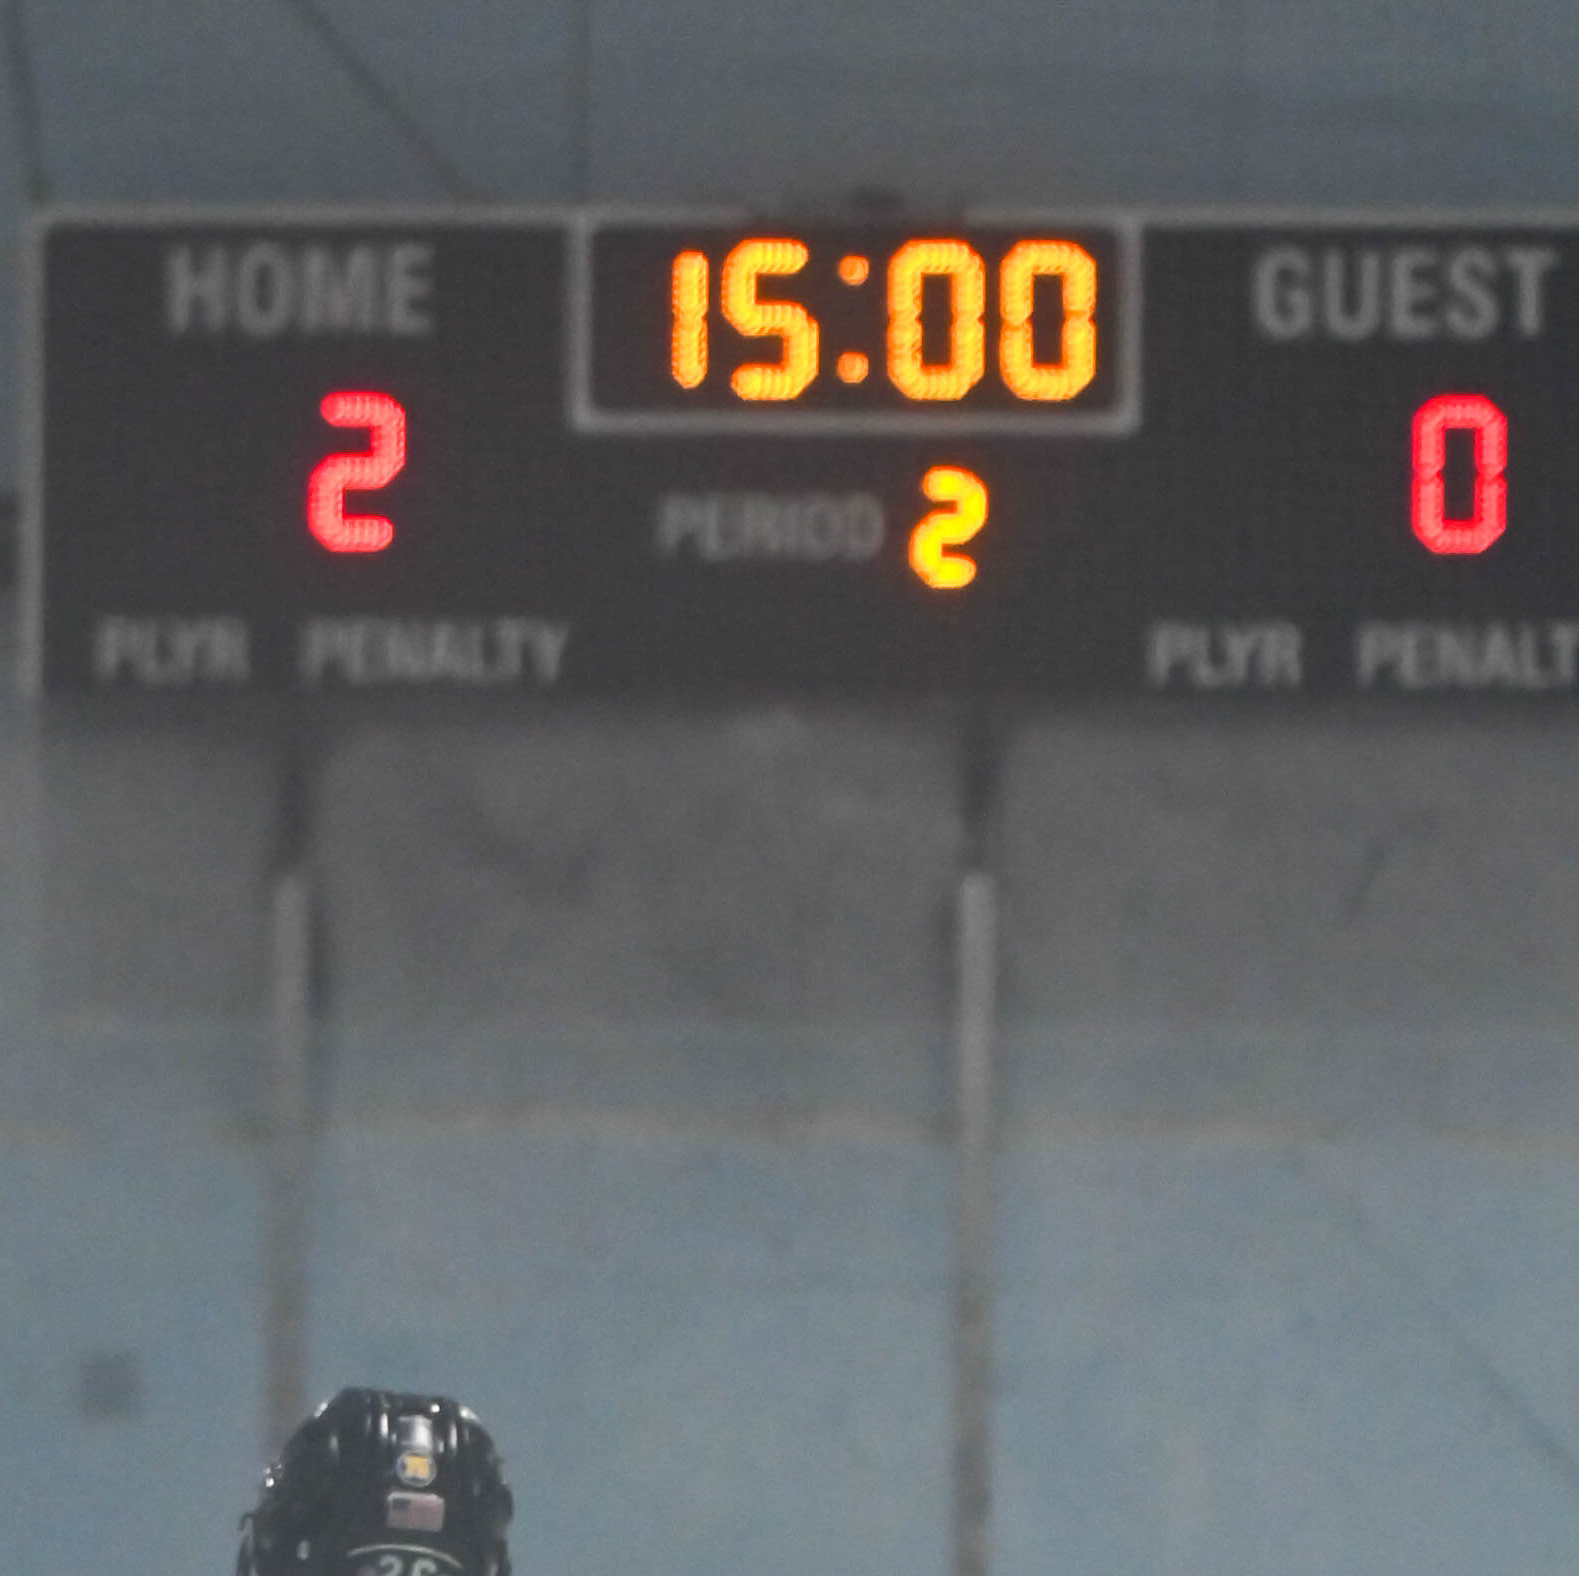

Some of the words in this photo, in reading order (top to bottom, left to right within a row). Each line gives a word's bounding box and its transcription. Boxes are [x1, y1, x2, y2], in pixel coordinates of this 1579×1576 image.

[164, 242, 433, 336] HOME
[671, 238, 1097, 400] 15:00
[1253, 247, 1558, 340] GUEST
[308, 391, 406, 553] 2
[1411, 395, 1508, 556] 0
[657, 491, 885, 561] PERIOD
[909, 466, 990, 589] 2
[95, 616, 250, 684] PLYR
[302, 616, 569, 684] PENALTY
[1148, 620, 1302, 687] PLYR
